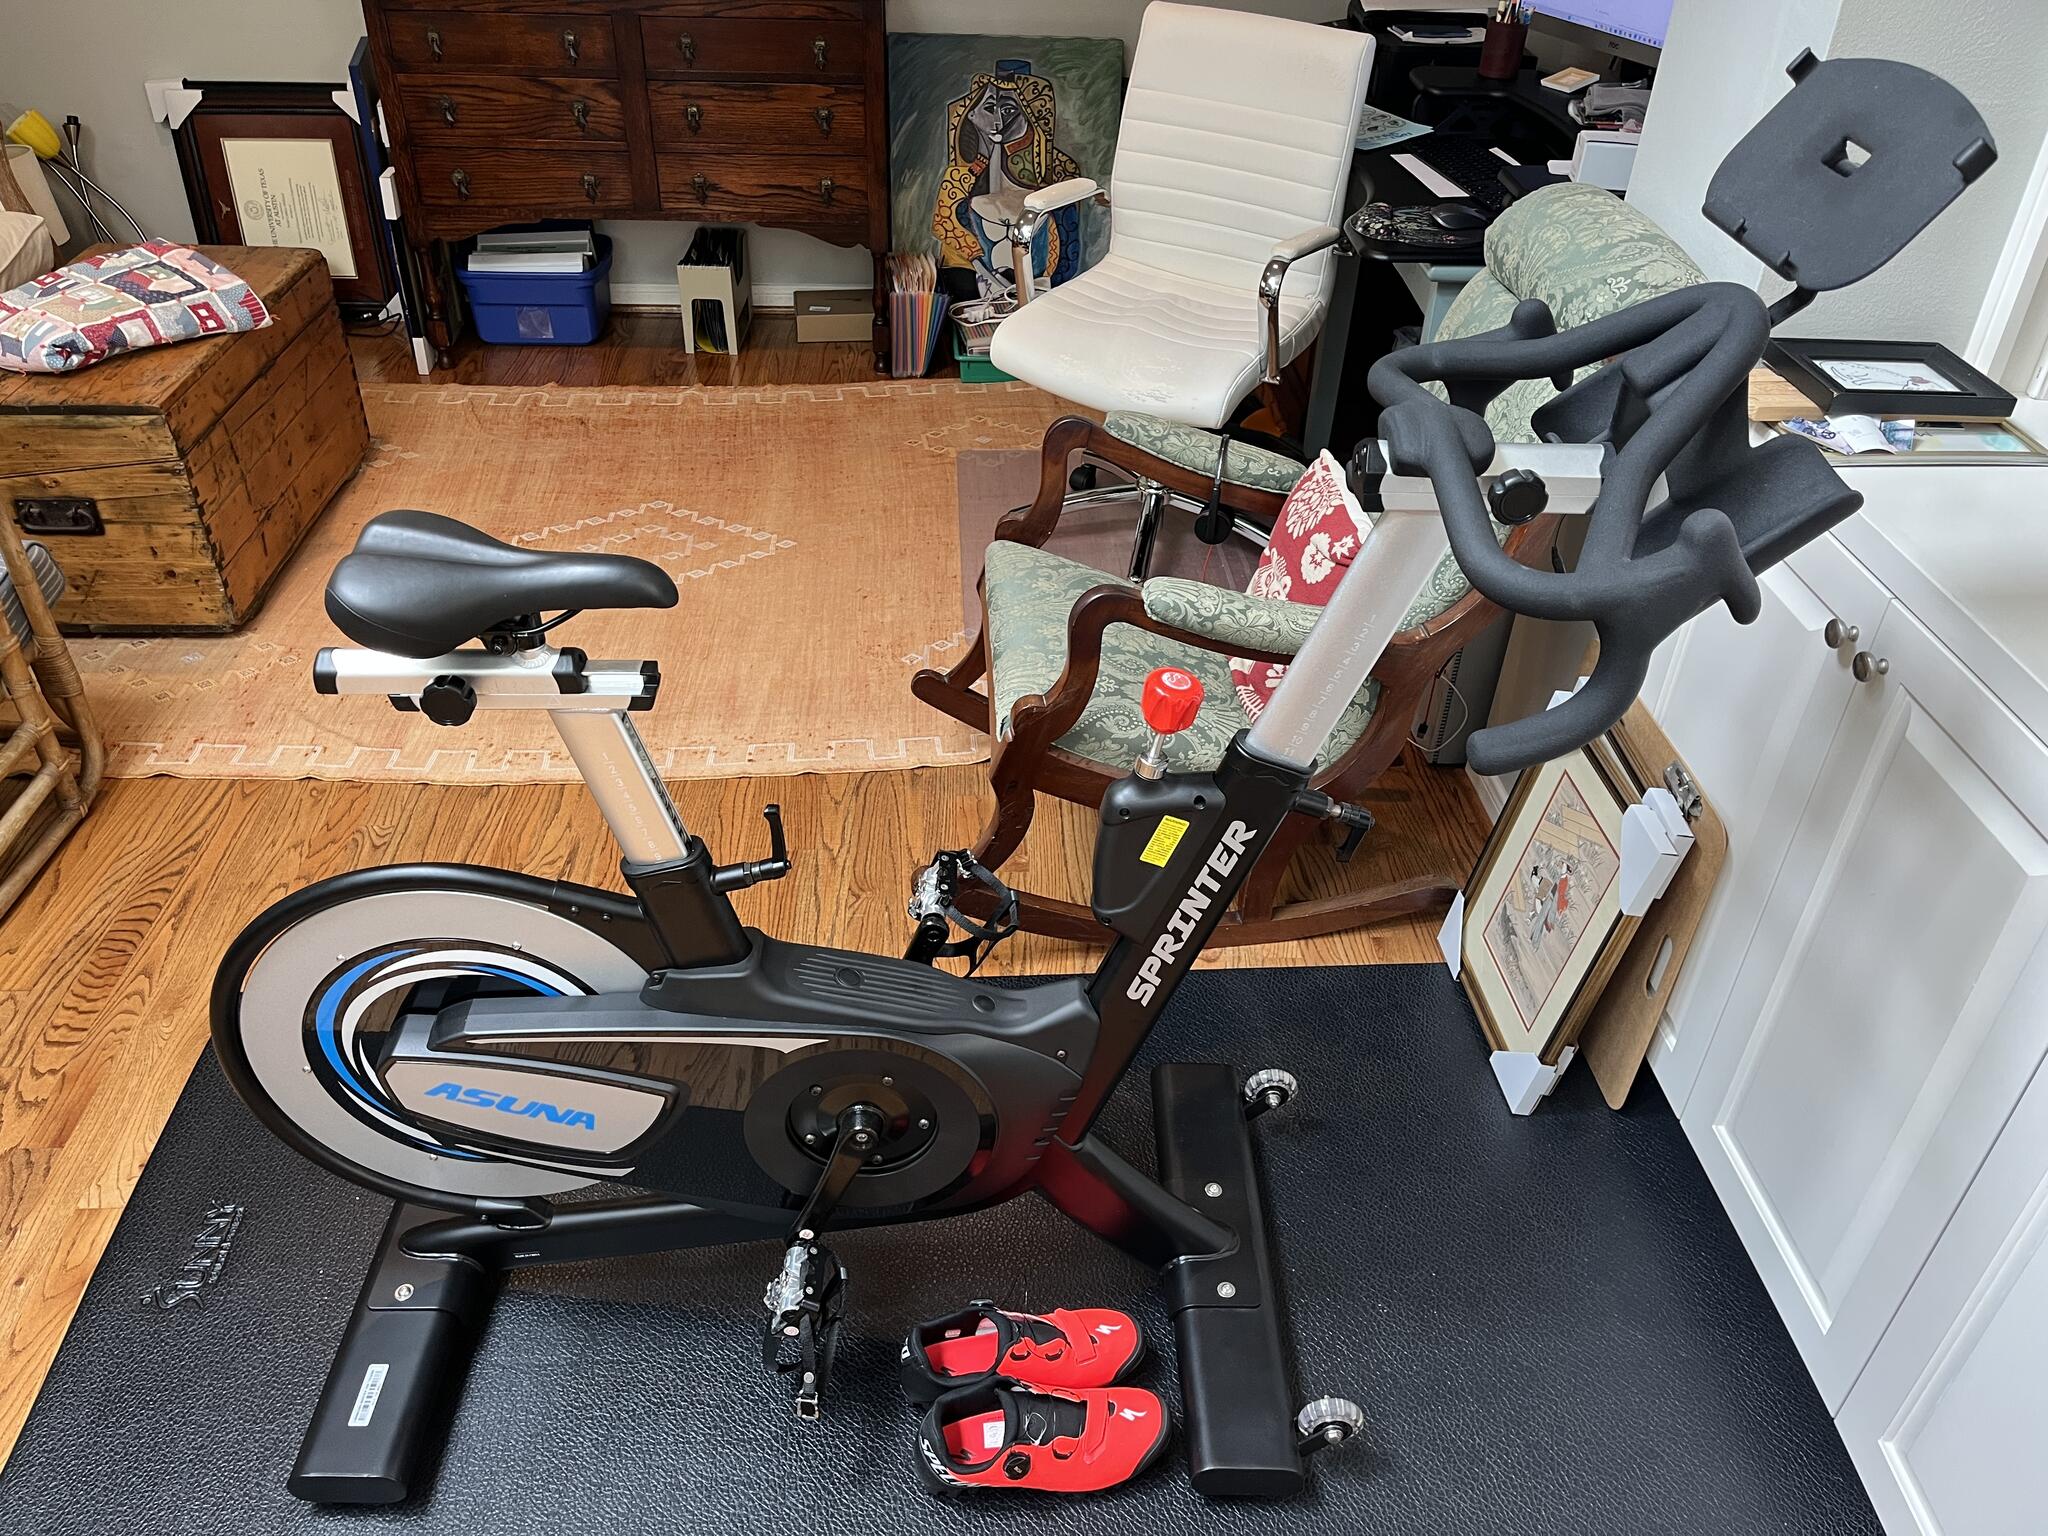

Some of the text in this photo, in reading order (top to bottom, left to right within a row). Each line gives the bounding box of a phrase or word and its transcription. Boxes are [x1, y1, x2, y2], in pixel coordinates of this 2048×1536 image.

[257, 167, 267, 189] TEXAS
[262, 191, 270, 200] OF
[270, 194, 280, 218] AUSTIN
[265, 200, 277, 239] UNIVERSITY
[1126, 820, 1258, 1007] SPRINTER
[424, 1082, 596, 1131] ASUNA
